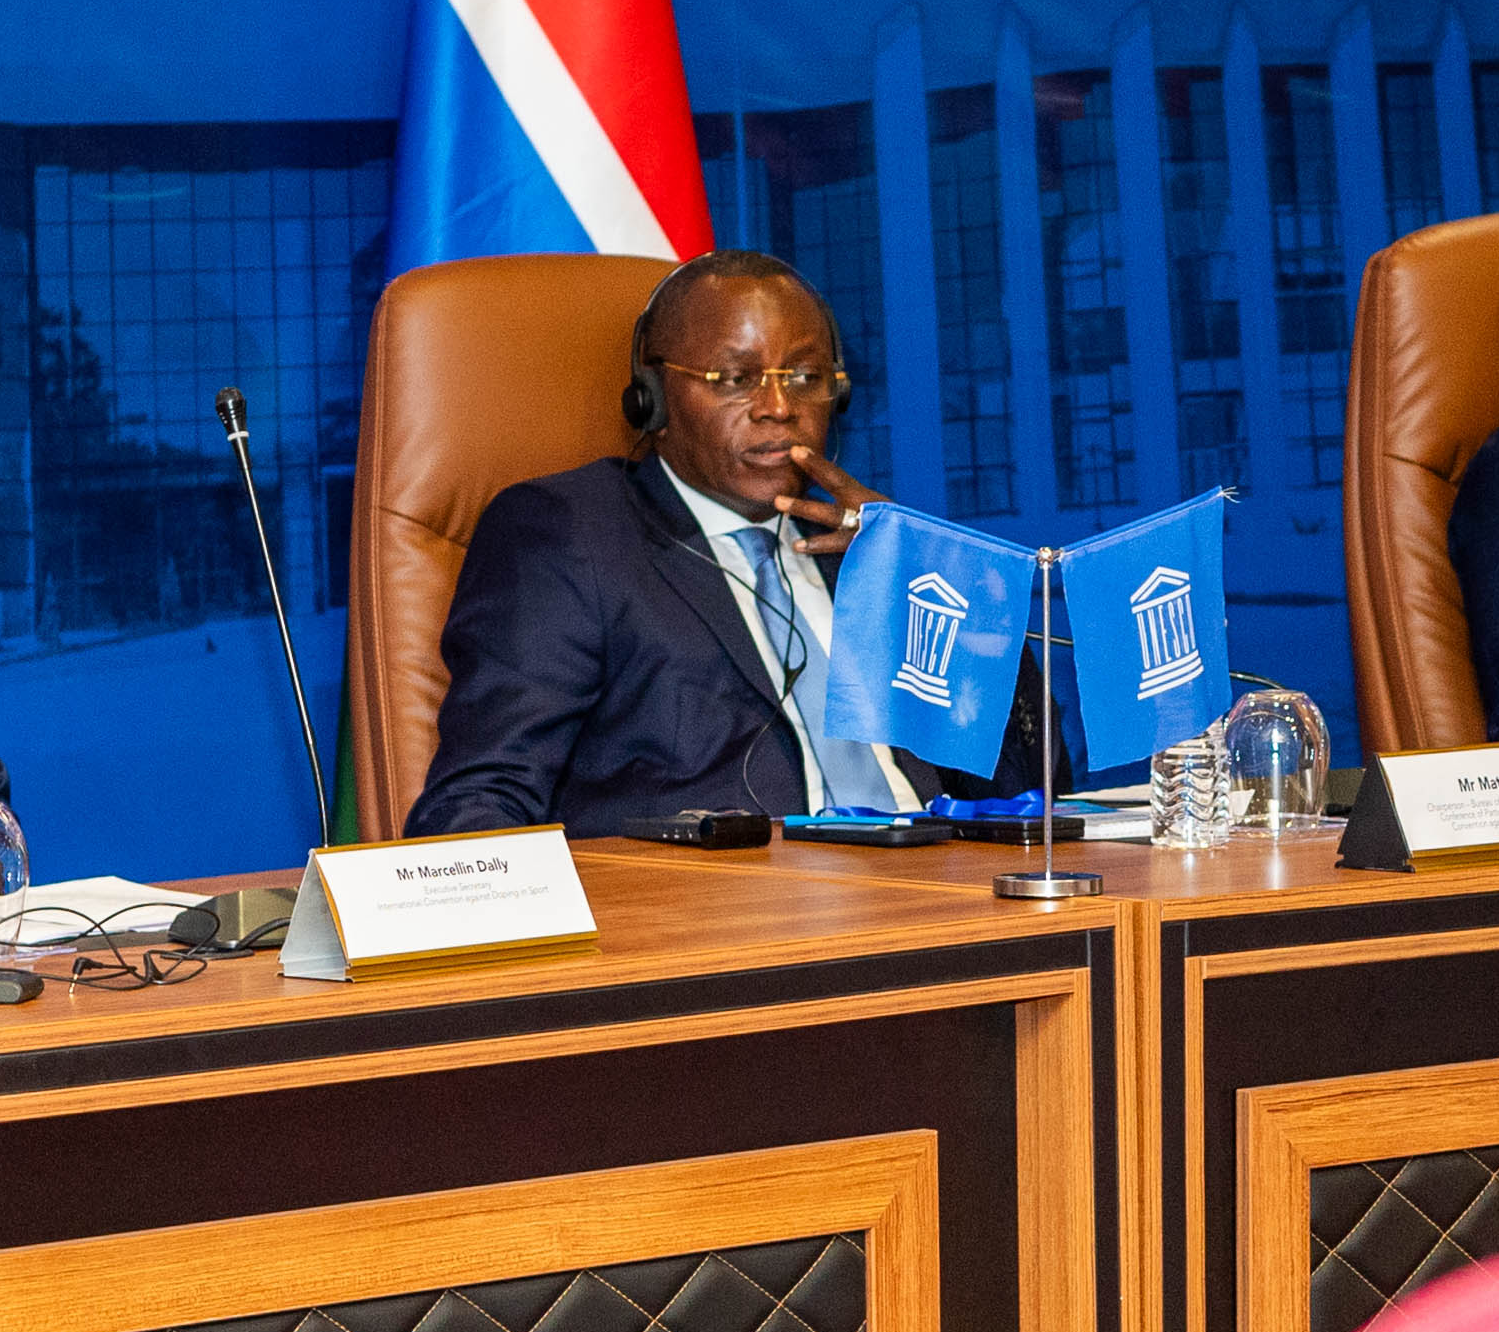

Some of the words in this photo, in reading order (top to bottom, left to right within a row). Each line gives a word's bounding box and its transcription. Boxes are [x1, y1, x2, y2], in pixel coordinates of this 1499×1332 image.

[1458, 778, 1475, 792] Mr
[396, 868, 415, 881] Mr
[417, 861, 475, 879] Marcellin
[476, 857, 509, 874] Dally
